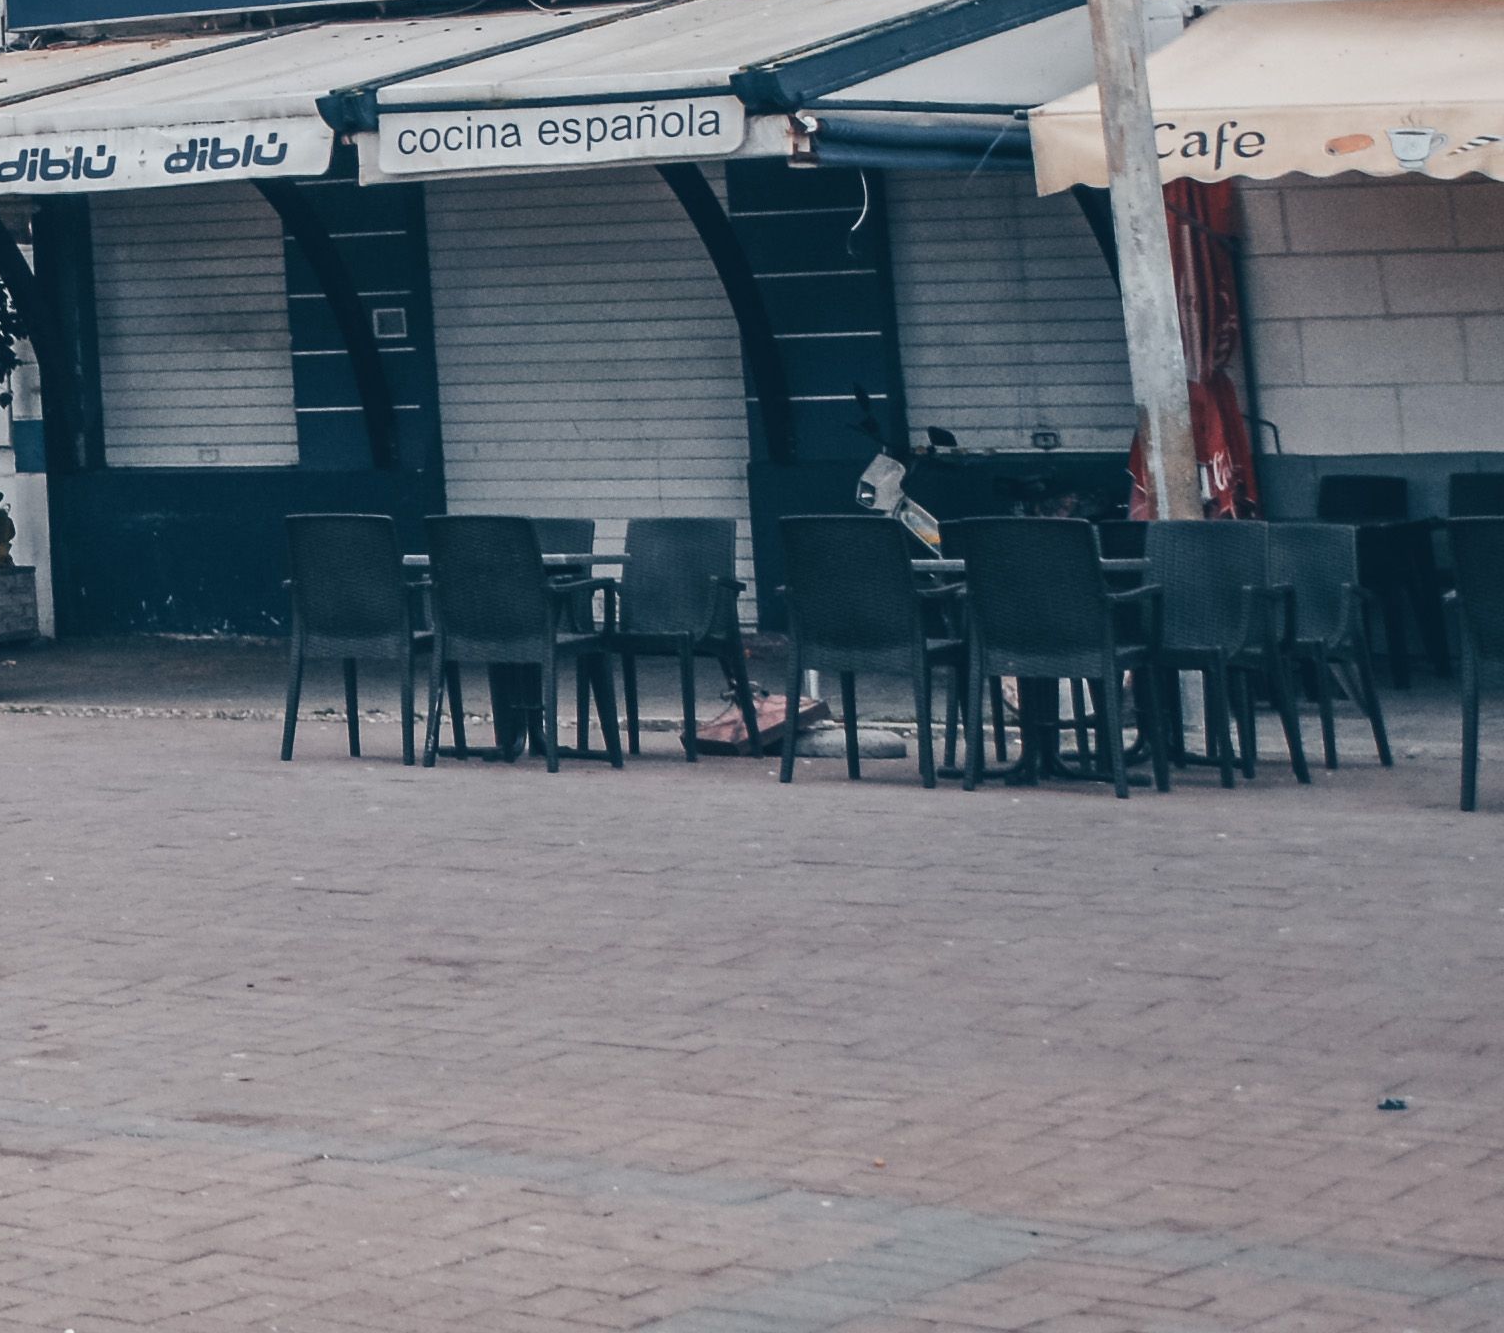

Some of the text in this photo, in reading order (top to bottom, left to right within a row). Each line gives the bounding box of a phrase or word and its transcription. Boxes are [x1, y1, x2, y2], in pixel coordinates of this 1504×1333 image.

[397, 104, 720, 155] cocina española
[1154, 120, 1266, 171] Cafe
